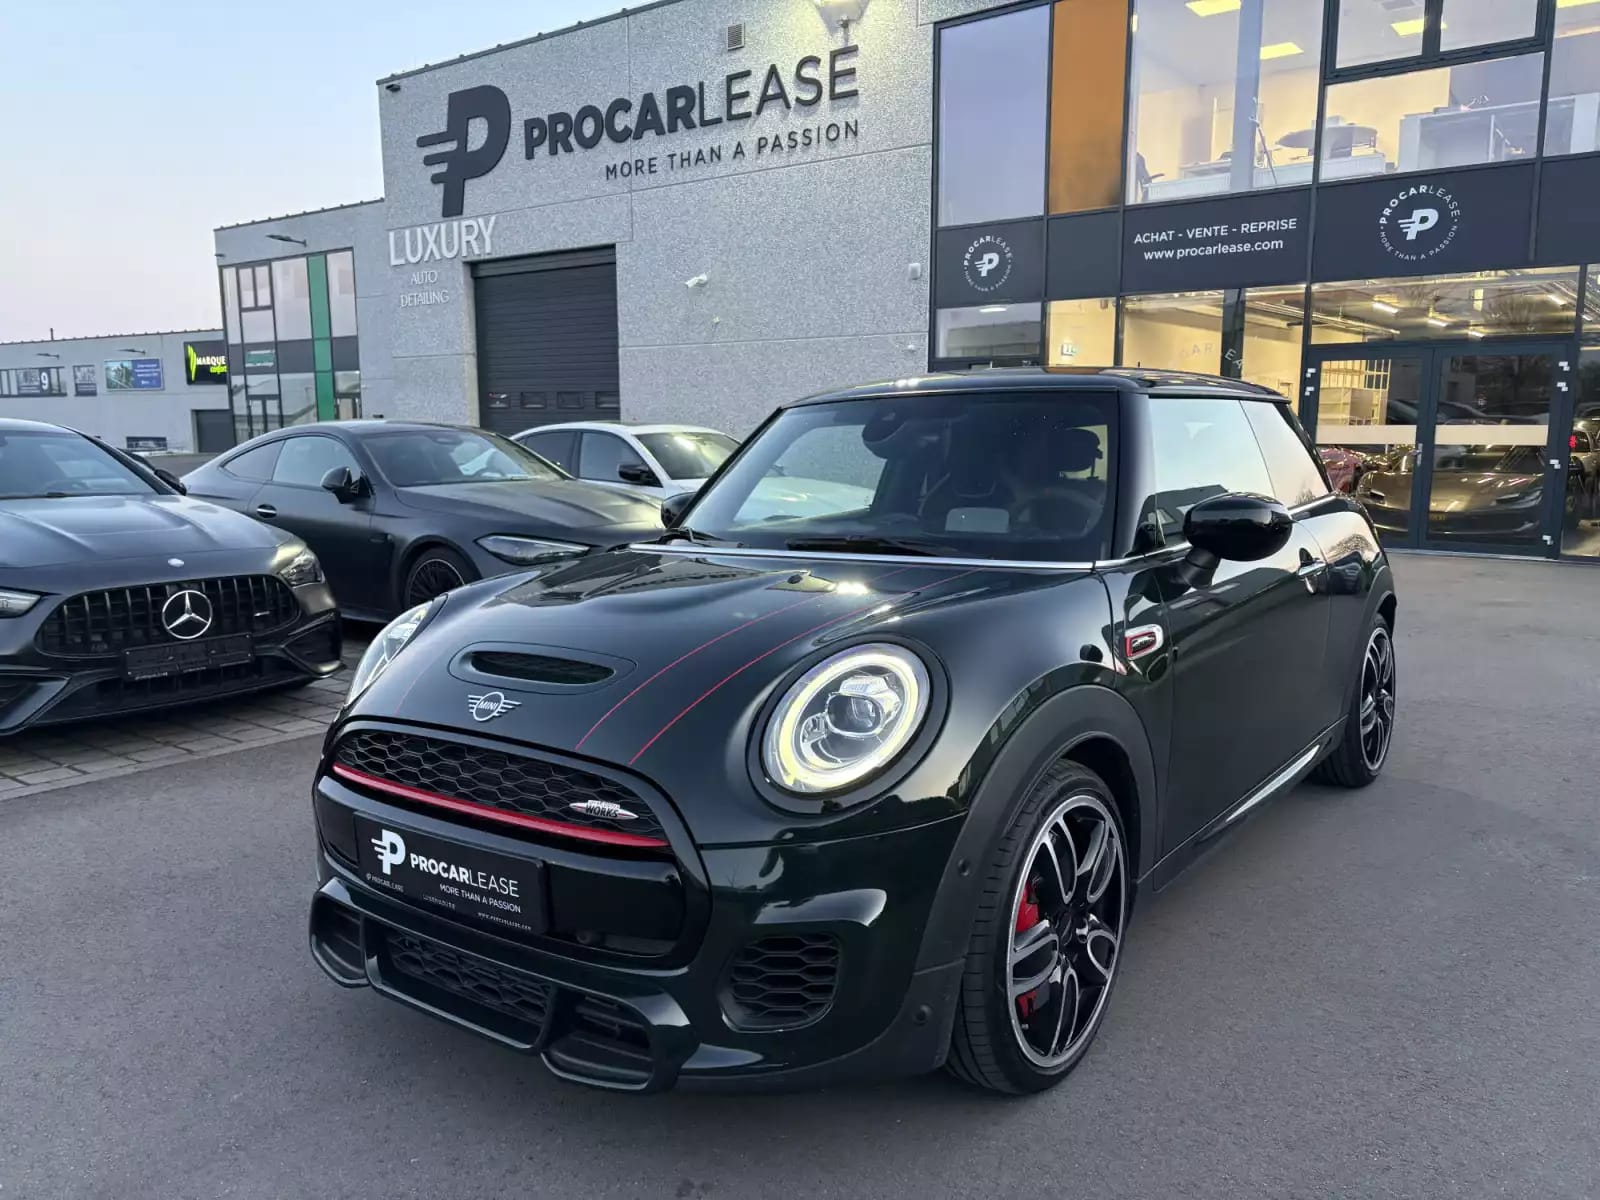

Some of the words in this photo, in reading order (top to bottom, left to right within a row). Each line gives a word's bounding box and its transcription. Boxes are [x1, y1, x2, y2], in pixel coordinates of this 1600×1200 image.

[523, 45, 860, 160] PROCARLEASE
[605, 157, 659, 181] MORE
[668, 145, 723, 171] THAN
[732, 141, 747, 159] A
[757, 119, 860, 154] PASSION
[1379, 184, 1461, 225] PROCARLEASE
[389, 216, 497, 267] LUXURY
[1134, 230, 1175, 244] ACHAT
[1186, 225, 1229, 239] VENTE
[1240, 218, 1298, 234] REPRISE
[1380, 231, 1394, 253] MORE
[411, 270, 438, 285] AUTO
[400, 290, 450, 308] DETAILING
[196, 355, 227, 366] MARQUE
[41, 371, 49, 390] 9
[478, 700, 499, 711] MINI
[585, 805, 619, 818] WORKS
[409, 852, 520, 898] PROCARLEASE
[439, 883, 460, 897] MORE
[460, 889, 481, 903] THAN
[482, 894, 489, 904] A
[488, 898, 522, 913] PASSION
